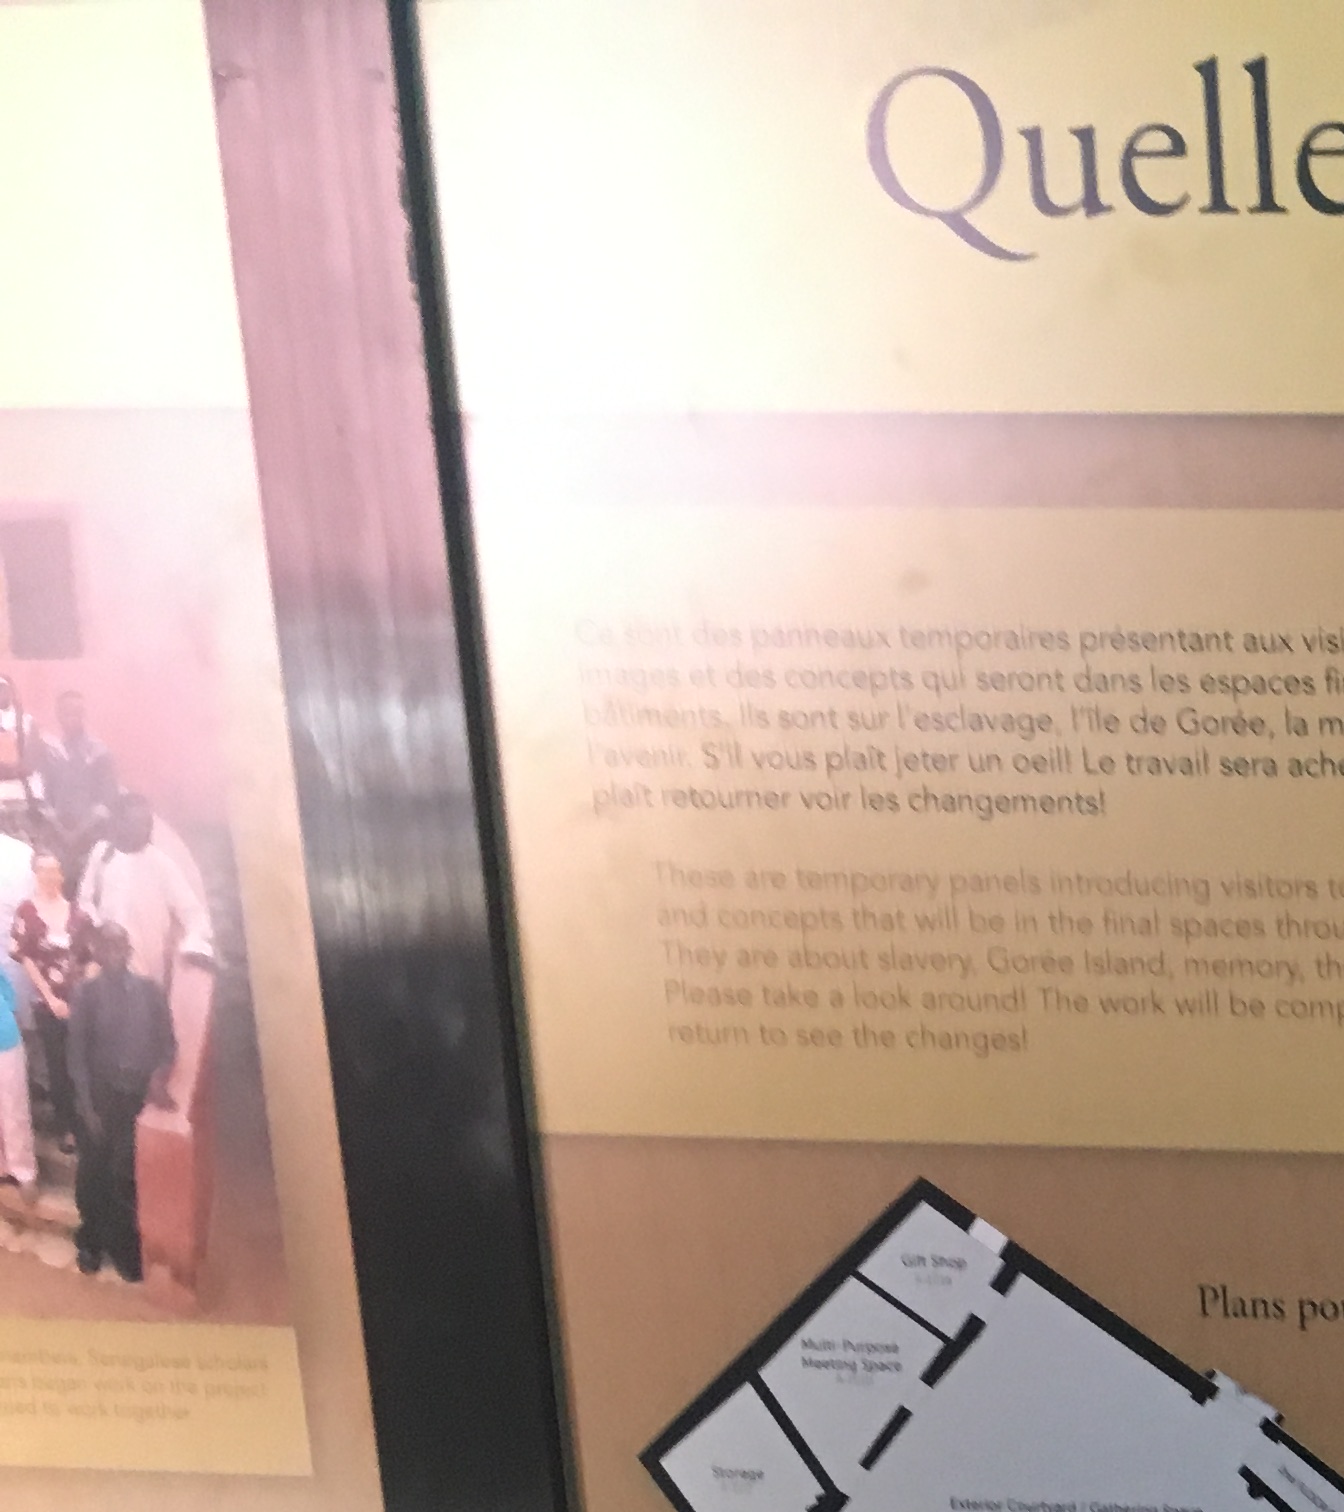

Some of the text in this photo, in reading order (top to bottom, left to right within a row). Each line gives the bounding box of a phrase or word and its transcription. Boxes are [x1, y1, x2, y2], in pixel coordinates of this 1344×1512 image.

[749, 627, 891, 658] panneaux
[898, 620, 1071, 659] temporaires
[1078, 622, 1234, 661] présentant
[1242, 632, 1294, 654] aux
[783, 659, 915, 698] concepts
[920, 661, 968, 699] qui
[974, 665, 1066, 693] seront
[1072, 662, 1144, 694] dans
[1149, 663, 1192, 694] les
[1198, 672, 1317, 703] espaces
[896, 699, 1064, 739] l'esclavage,
[1069, 702, 1122, 733] l'île
[1128, 703, 1169, 734] de
[1174, 703, 1276, 738] Gorée,
[1283, 705, 1311, 736] la
[700, 739, 744, 770] S'il
[750, 748, 818, 771] vous
[824, 741, 887, 779] plaît
[894, 742, 958, 780] jeter
[967, 751, 1004, 773] un
[1011, 743, 1072, 774] oeil!
[1081, 744, 1116, 775] Le
[1124, 745, 1210, 776] travail
[1219, 755, 1279, 777] sera
[591, 778, 1110, 823] plaît retourner voir les changements!
[715, 901, 846, 940] concepts
[850, 904, 907, 933] that
[913, 905, 961, 934] will
[967, 906, 1007, 935] be
[1013, 907, 1040, 936] in
[1047, 907, 1095, 937] the
[1101, 908, 1162, 938] final
[1168, 916, 1267, 948] spaces
[662, 978, 749, 1008] Please
[759, 980, 822, 1009] take
[827, 988, 847, 1010] a
[851, 981, 914, 1011] look
[918, 983, 1029, 1013] around!
[1037, 985, 1091, 1015] The
[1097, 986, 1168, 1016] work
[1172, 988, 1222, 1017] will
[1227, 989, 1268, 1018] be
[1198, 1282, 1286, 1321] Plans
